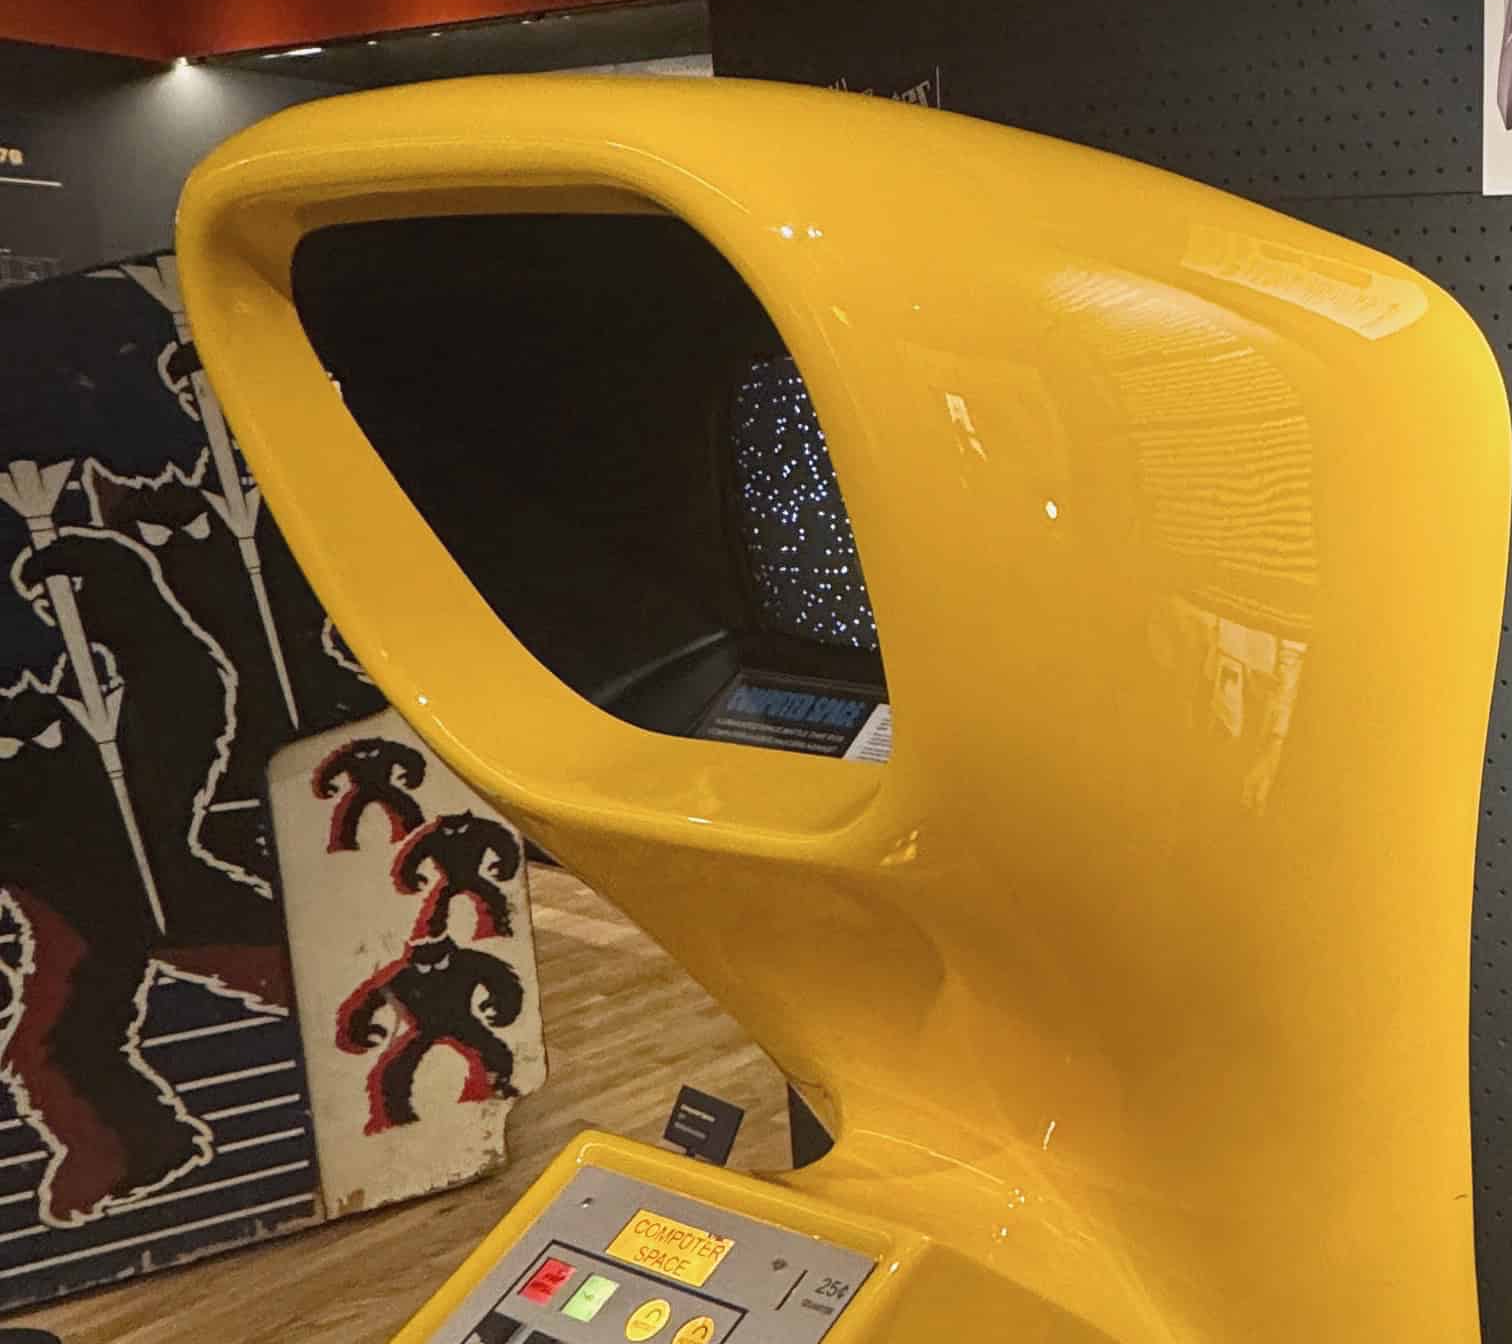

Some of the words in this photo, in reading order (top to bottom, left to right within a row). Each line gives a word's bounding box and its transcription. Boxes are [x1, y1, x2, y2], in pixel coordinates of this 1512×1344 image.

[634, 1219, 726, 1262] COMPUTER
[634, 1246, 691, 1277] SPACE
[815, 1277, 849, 1300] 25¢
